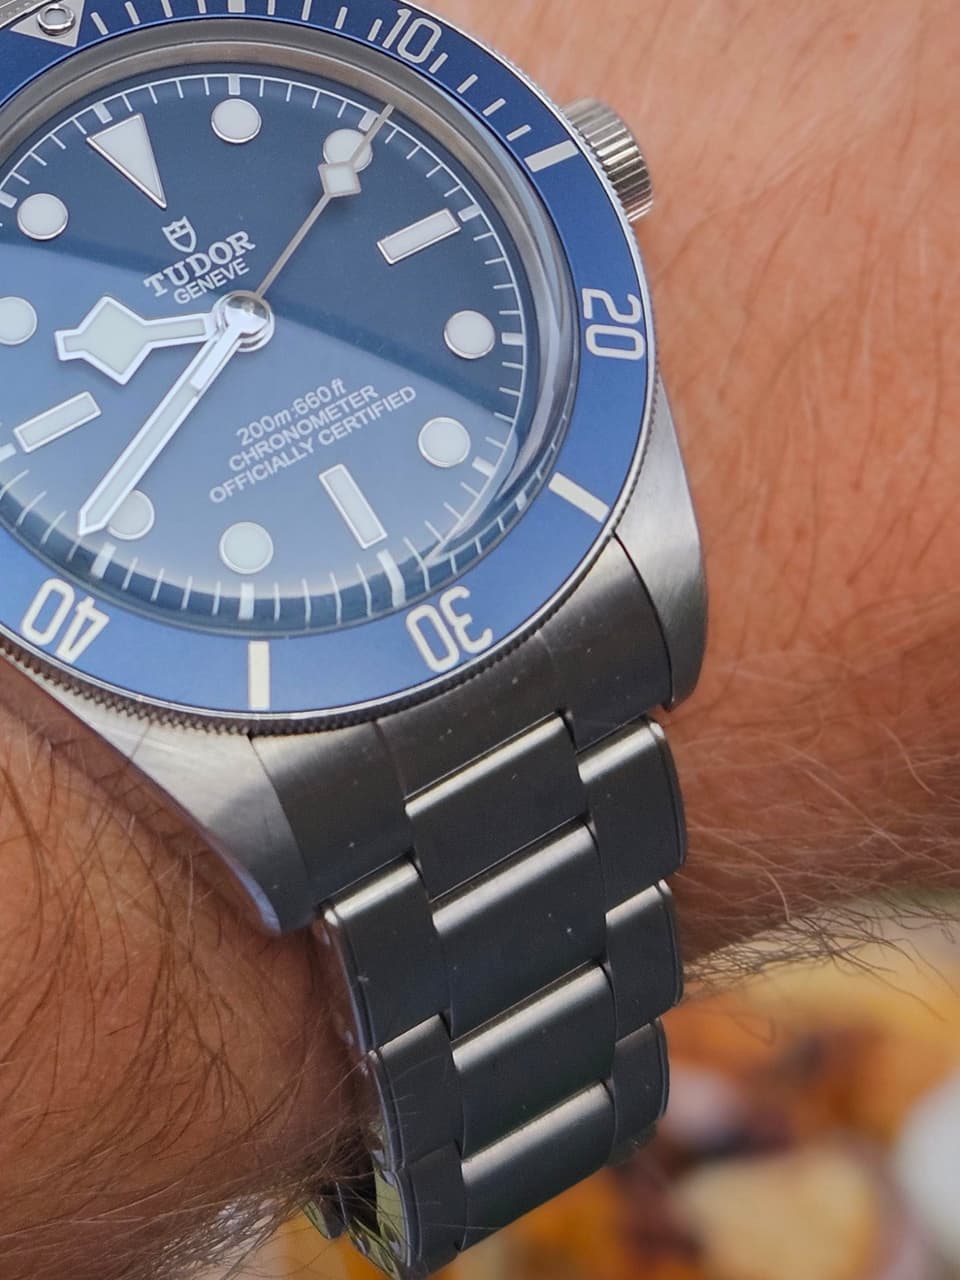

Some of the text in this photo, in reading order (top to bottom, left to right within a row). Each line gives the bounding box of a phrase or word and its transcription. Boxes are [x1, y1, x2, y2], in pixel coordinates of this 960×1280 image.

[382, 8, 442, 64] 10
[143, 230, 256, 297] TUDOR
[173, 258, 250, 304] GENEVE
[582, 288, 646, 360] 20
[209, 386, 417, 504] OFFICIALLY CERTIFIED
[228, 385, 379, 472] CHRONOMETER
[21, 578, 110, 664] 40
[405, 585, 493, 673] 30
